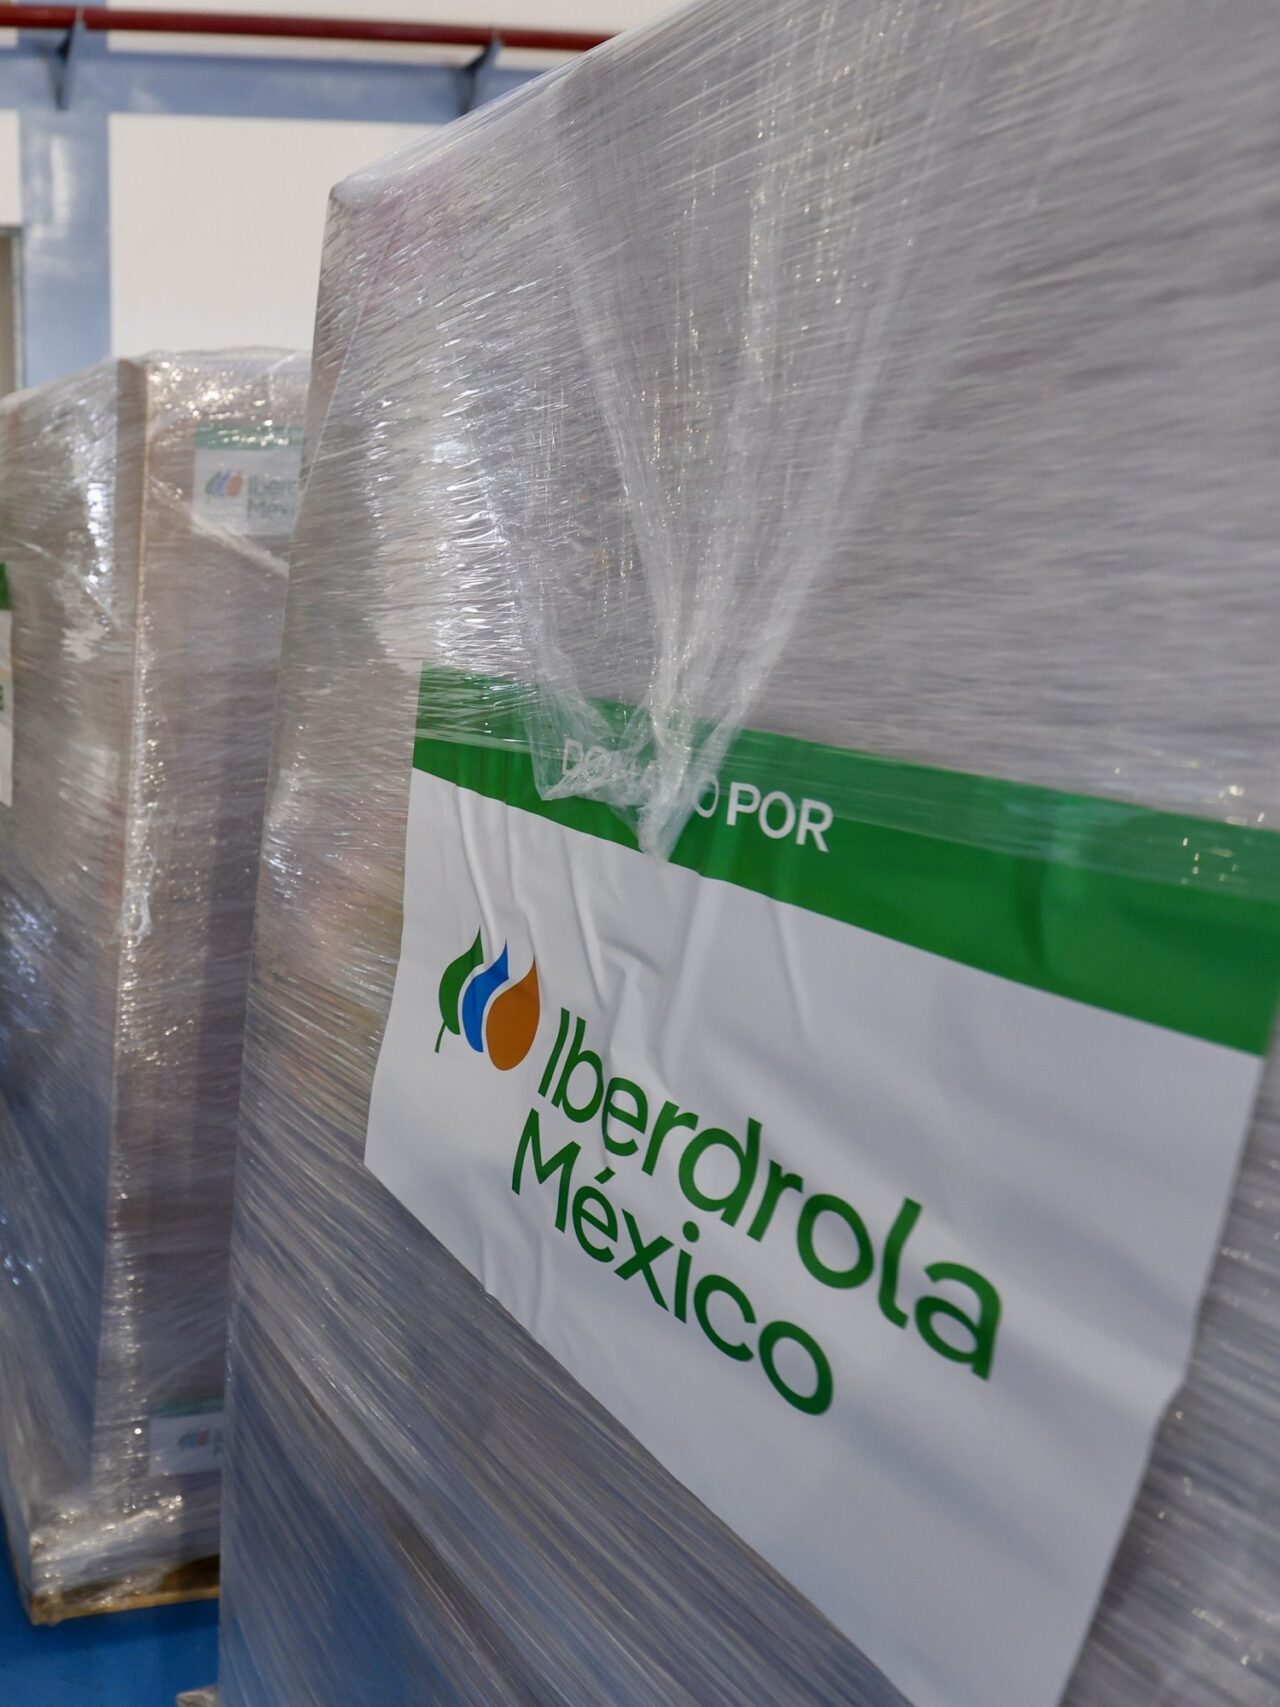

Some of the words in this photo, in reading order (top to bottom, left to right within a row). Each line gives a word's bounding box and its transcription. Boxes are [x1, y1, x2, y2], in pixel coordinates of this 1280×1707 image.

[726, 781, 834, 852] POR
[511, 1107, 834, 1416] México
[537, 1007, 1002, 1382] Iberdrola
